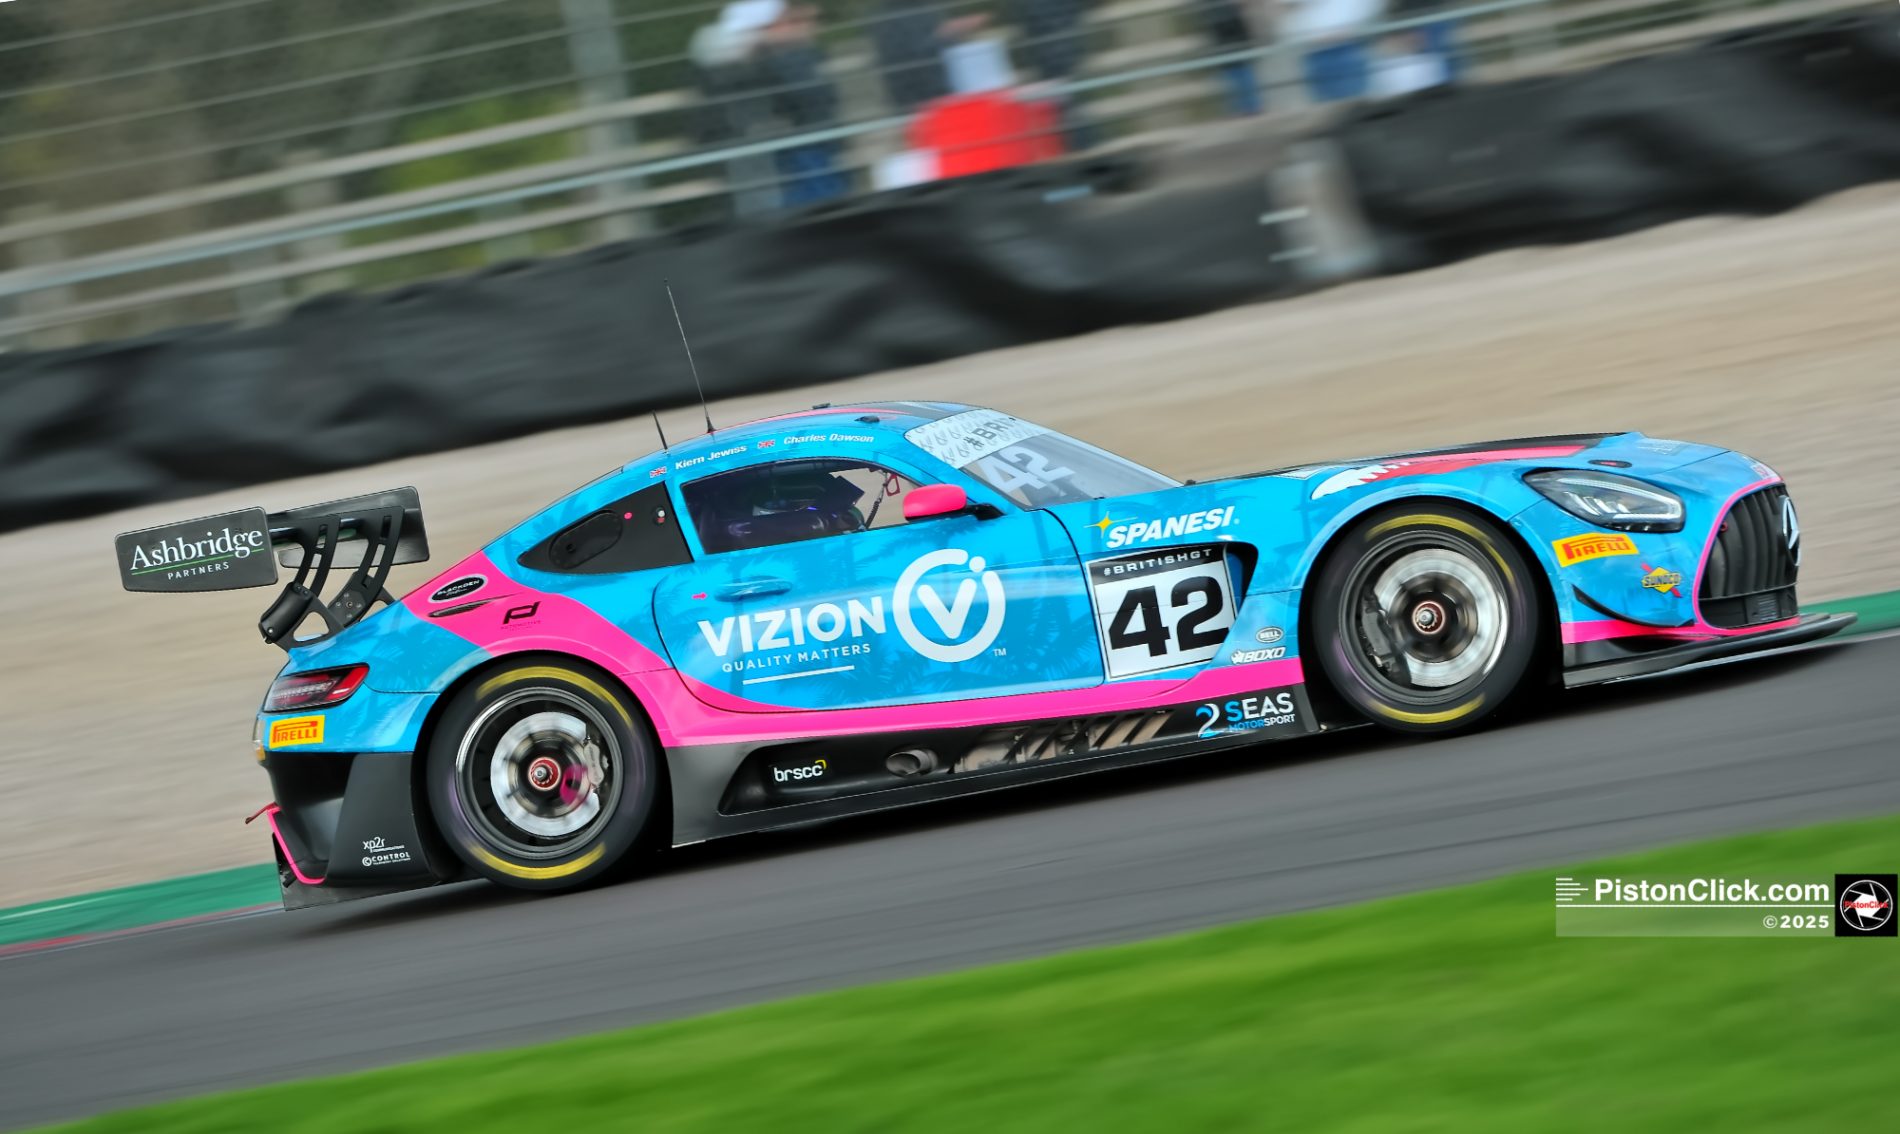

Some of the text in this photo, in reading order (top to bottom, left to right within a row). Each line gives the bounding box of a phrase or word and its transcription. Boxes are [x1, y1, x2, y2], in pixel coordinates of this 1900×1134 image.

[783, 433, 875, 445] Charles Dawson
[675, 445, 747, 470] Kiern Jewiss
[977, 445, 1076, 494] 42
[1106, 506, 1235, 549] SPANESI
[129, 526, 264, 571] Ashbridge
[1562, 536, 1630, 560] PIRELLI
[167, 561, 230, 580] PARTNERS
[1103, 548, 1213, 576] #BRITISHGT
[697, 596, 887, 658] VIZION
[1108, 575, 1230, 658] 42
[722, 643, 871, 674] QUALITY MATTERS
[1243, 646, 1286, 663] BOXO
[1224, 692, 1294, 722] SEAS
[272, 720, 318, 743] PIRELLI
[1228, 713, 1296, 731] MOTORSPORT
[773, 764, 823, 783] brscc
[371, 851, 411, 862] CONTROL
